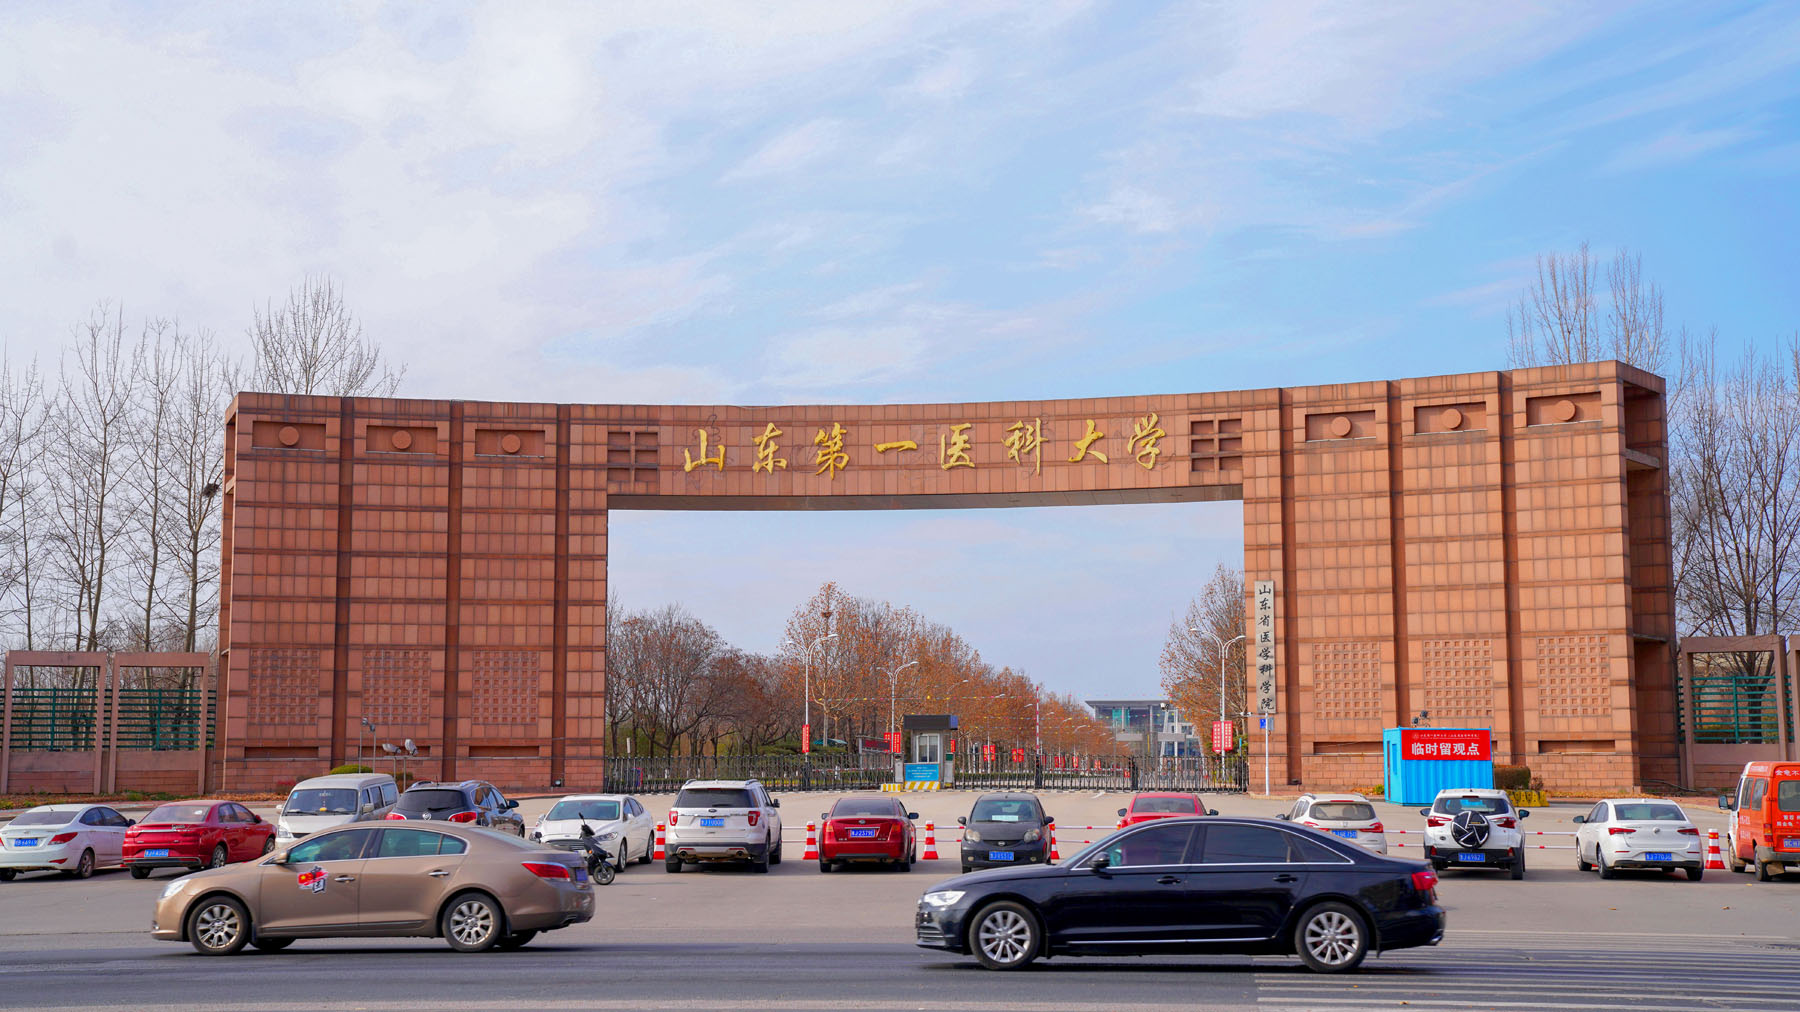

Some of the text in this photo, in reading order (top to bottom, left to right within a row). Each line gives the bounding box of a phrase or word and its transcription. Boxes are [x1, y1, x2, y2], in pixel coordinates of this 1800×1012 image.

[684, 412, 1166, 481] 山东第一医科大学
[1258, 584, 1275, 711] 山东省医学科学院
[1411, 741, 1480, 756] 临时留观点
